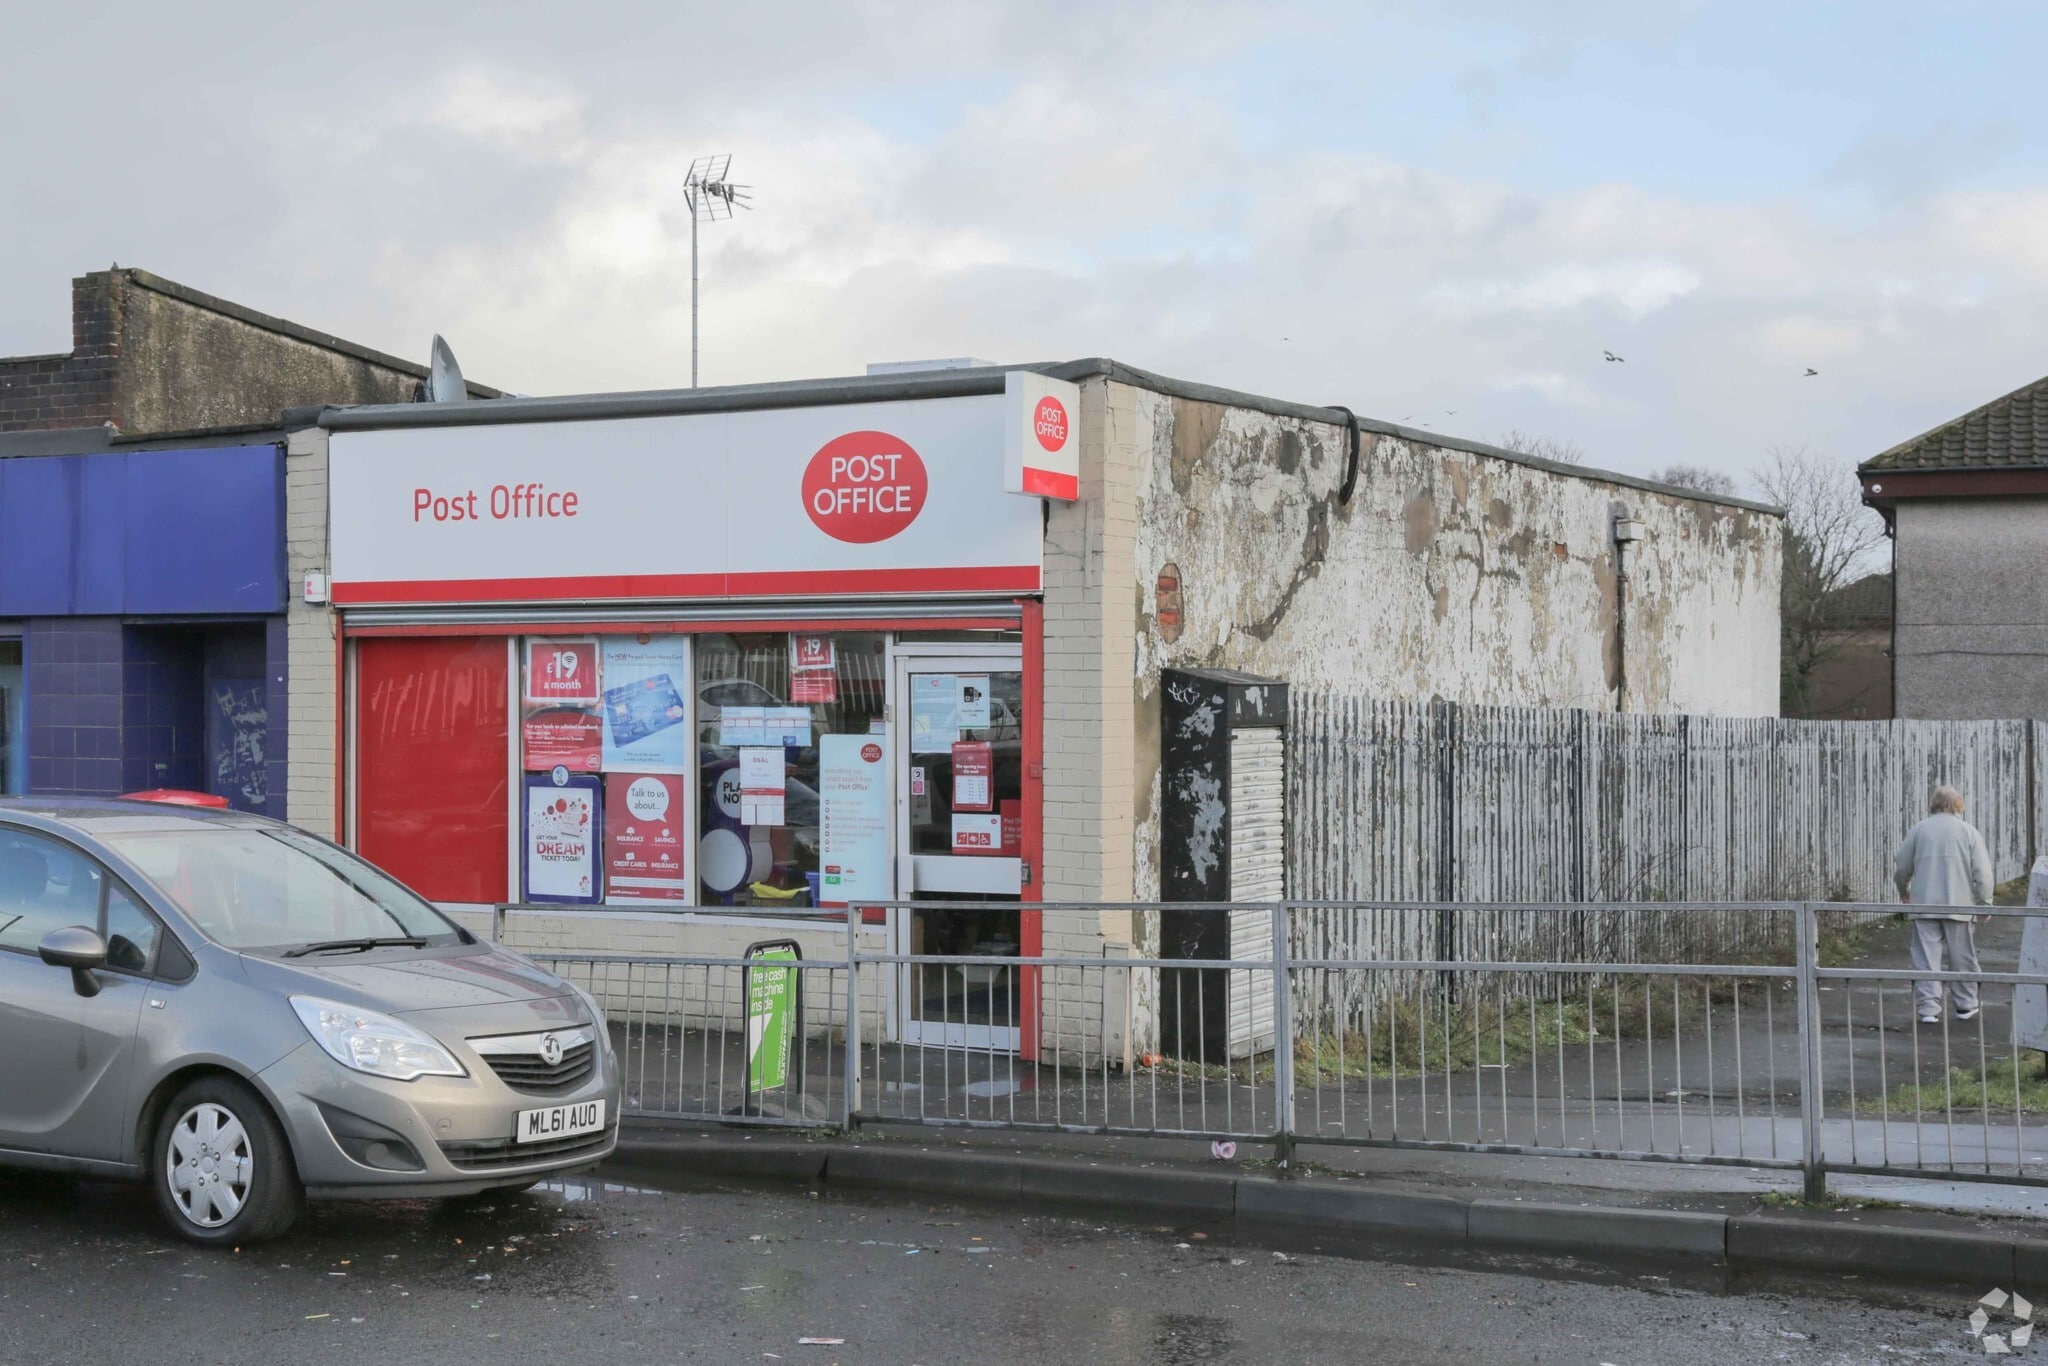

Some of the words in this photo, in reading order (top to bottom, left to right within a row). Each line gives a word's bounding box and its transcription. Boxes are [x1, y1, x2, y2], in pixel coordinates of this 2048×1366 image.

[1041, 406, 1062, 424] POST
[1036, 421, 1065, 440] OFFICE
[831, 454, 902, 483] POST
[414, 488, 479, 522] Post
[490, 483, 579, 519] Office
[813, 485, 912, 515] OFFICE
[551, 679, 582, 690] month
[631, 788, 645, 797] Talk
[647, 790, 655, 798] to
[723, 782, 741, 793] PLA
[723, 794, 741, 804] NO
[616, 835, 644, 843] INSURANCE
[654, 836, 676, 844] SAVINGS
[536, 841, 586, 856] DREAM
[768, 967, 786, 982] cash
[752, 997, 774, 1013] insde
[529, 1108, 565, 1135] ML61
[569, 1103, 597, 1129] AUO
